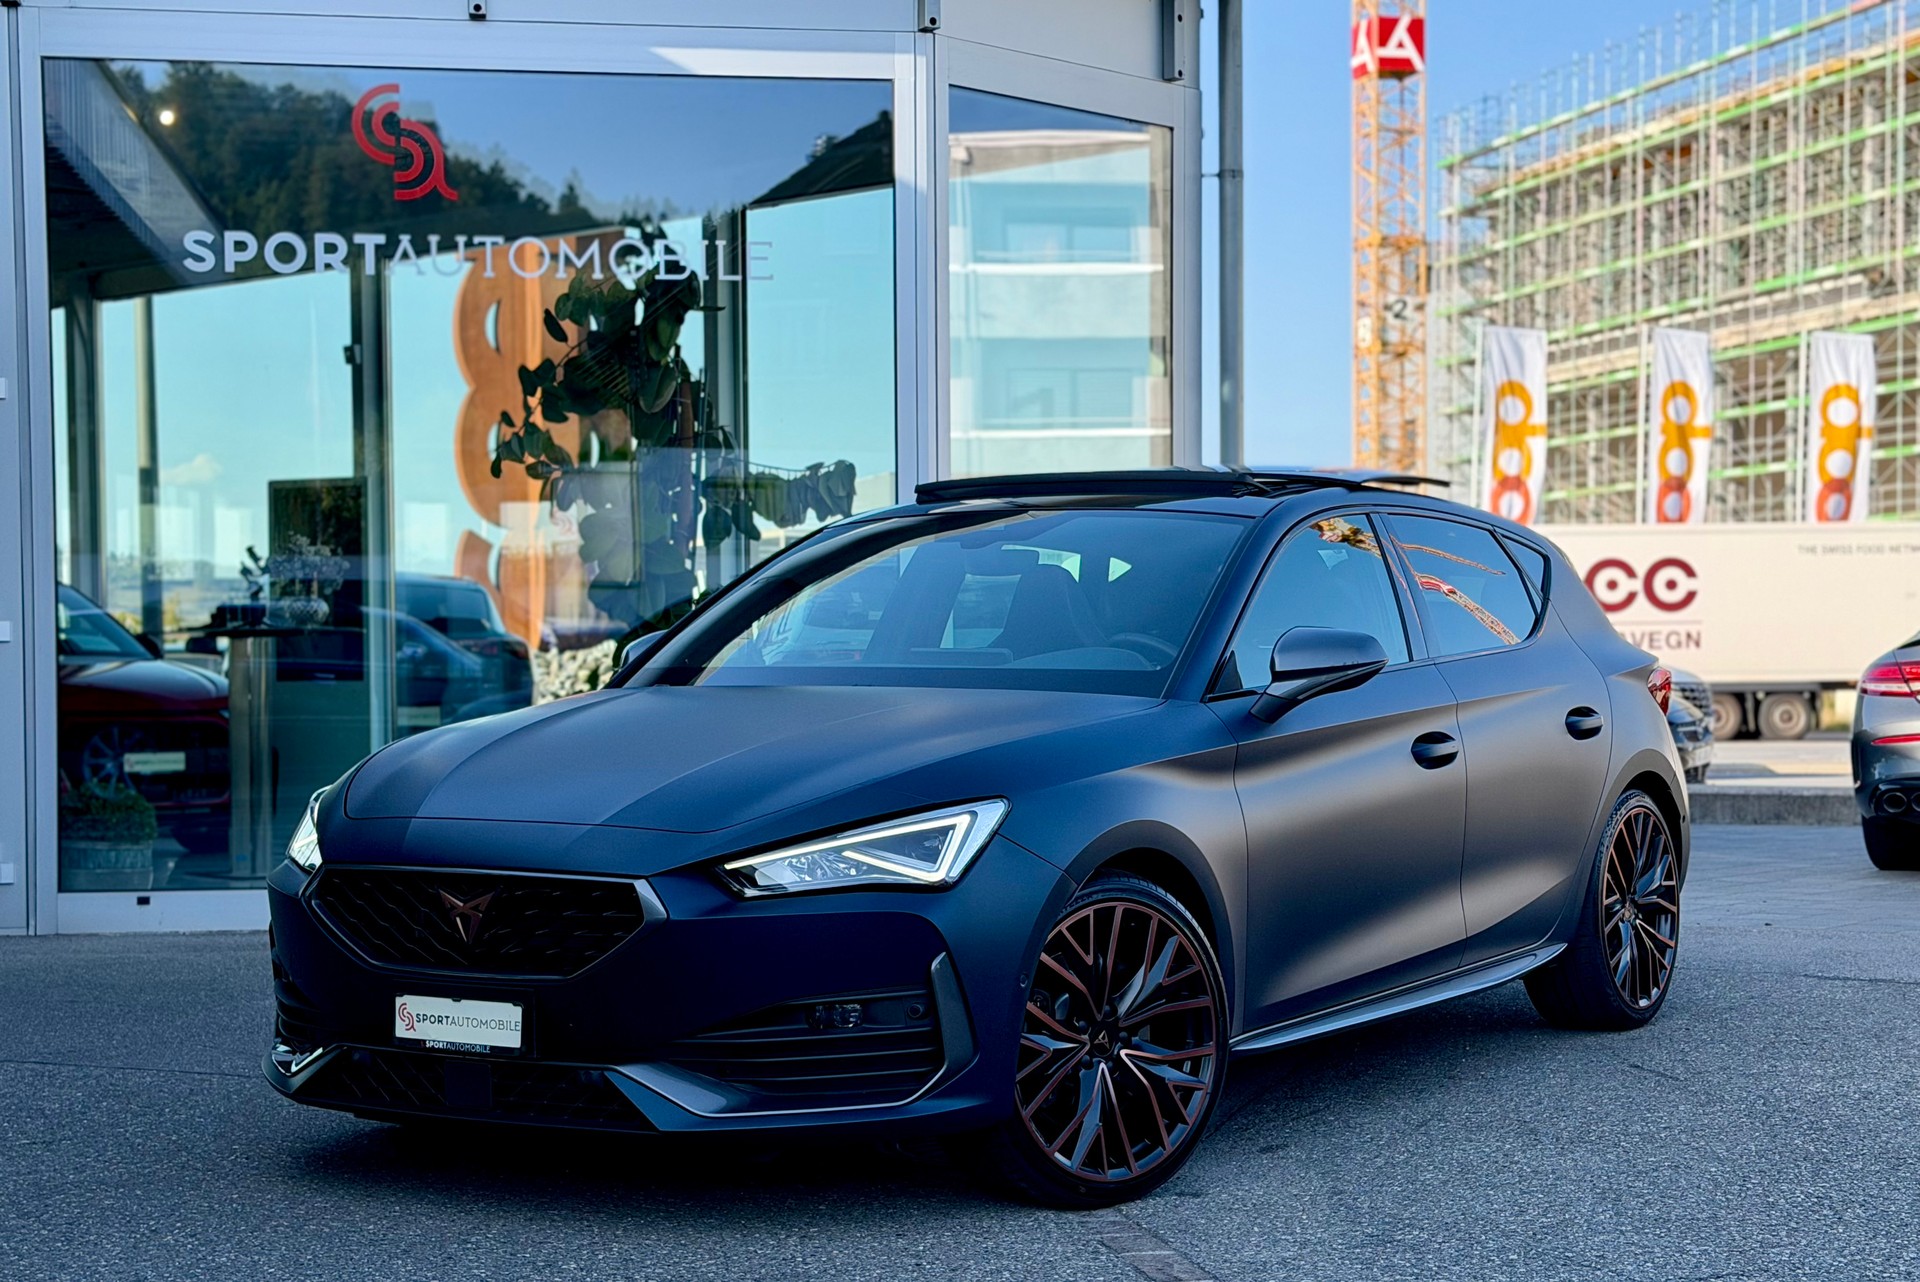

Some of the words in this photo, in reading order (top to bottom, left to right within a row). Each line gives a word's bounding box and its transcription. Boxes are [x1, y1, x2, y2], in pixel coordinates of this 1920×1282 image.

[182, 229, 774, 282] SPORTAUTOMOBILE
[415, 1013, 520, 1032] SPORTAUTOMOBILE
[425, 1040, 491, 1054] SPORTAUTOMOBILE
